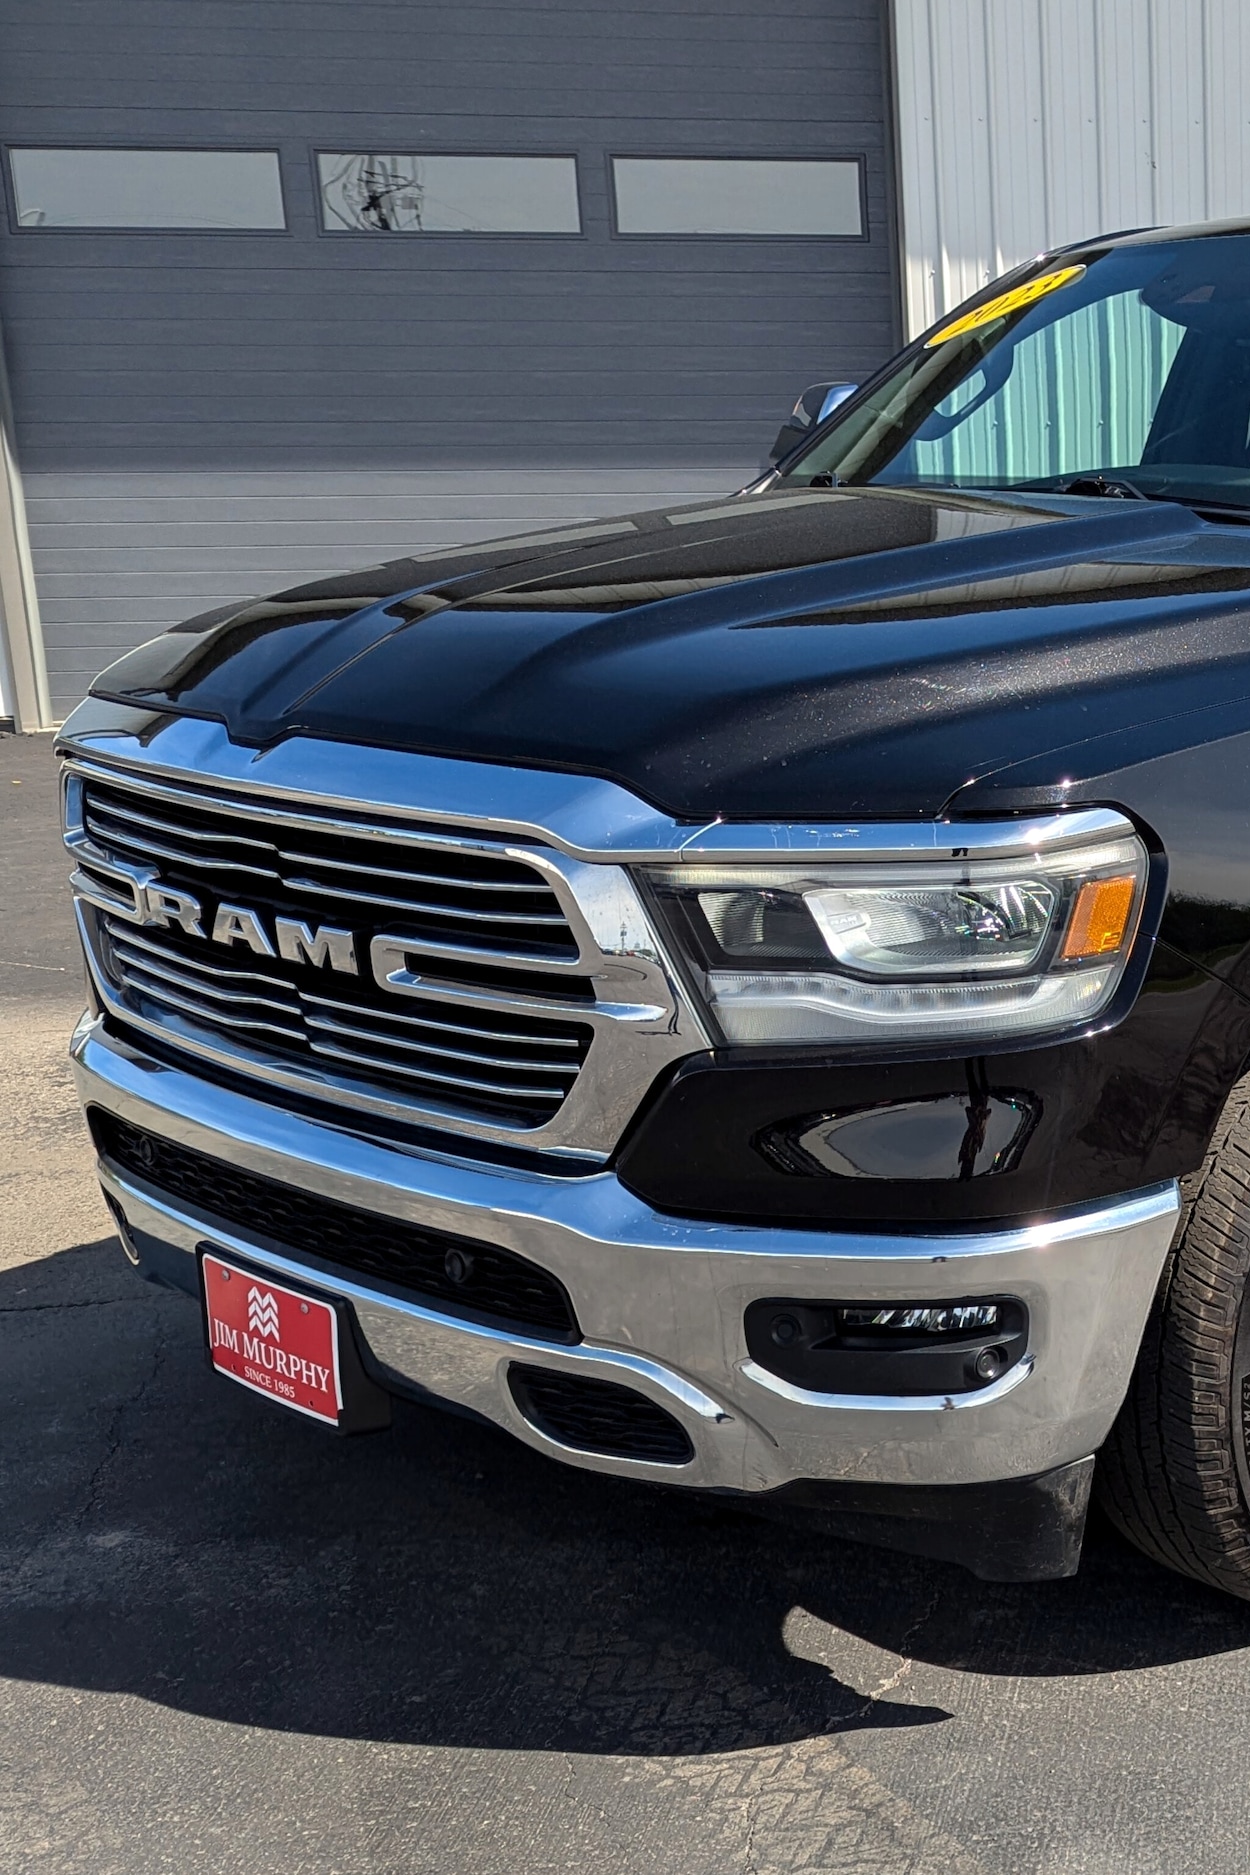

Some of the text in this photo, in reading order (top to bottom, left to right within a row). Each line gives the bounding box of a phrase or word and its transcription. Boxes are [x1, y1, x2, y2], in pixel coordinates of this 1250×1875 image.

[147, 879, 359, 976] RAM
[213, 1318, 330, 1393] JIM MURPHY
[244, 1365, 296, 1399] SINCE 1985
